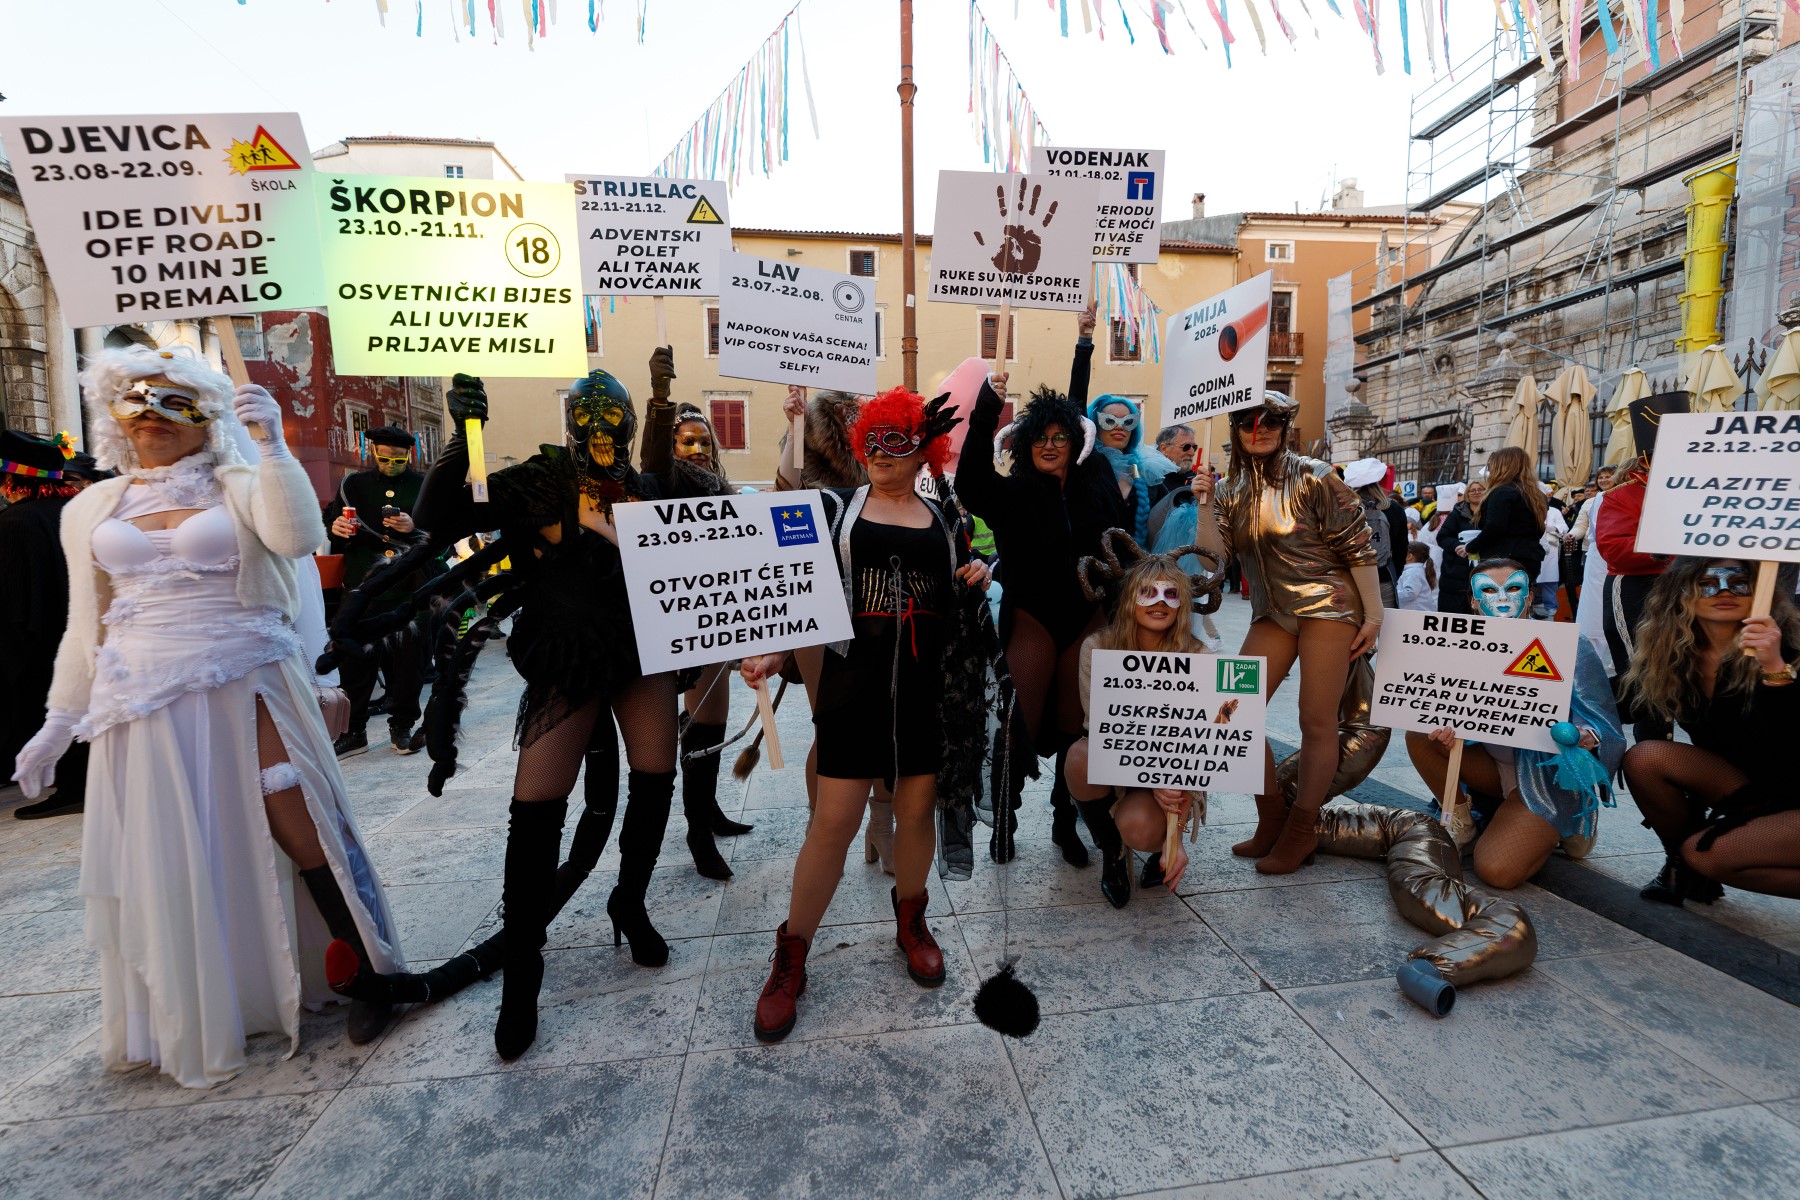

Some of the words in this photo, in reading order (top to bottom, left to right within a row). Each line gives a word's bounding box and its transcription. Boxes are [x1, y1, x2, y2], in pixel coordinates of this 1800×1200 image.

[21, 124, 211, 154] DJEVICA
[1046, 150, 1149, 168] VODENJAK
[32, 161, 203, 182] 23.08-22.09.
[1048, 170, 1122, 180] 2101.-18.02.
[251, 179, 297, 191] ŠKOLA
[574, 180, 697, 199] STRIJELAC
[330, 179, 524, 218] ŠKORPION
[582, 202, 666, 213] 22.11-21.12.
[83, 208, 143, 231] IDE
[153, 202, 263, 227] DIVLJI
[1096, 217, 1116, 228] ĆE
[1119, 218, 1154, 229] MOĆI
[338, 218, 484, 238] 23.10.-21.11.
[590, 228, 700, 242] ADVENTSKI
[1109, 231, 1144, 242] VAŠE
[86, 236, 154, 258] OFF
[166, 230, 275, 254] ROAD-
[516, 236, 550, 264] 18
[617, 245, 680, 257] POLET
[1092, 244, 1131, 256] DIŠTE
[112, 264, 147, 285] 10
[158, 259, 222, 282] MIN
[232, 256, 268, 276] JE
[597, 261, 629, 272] ALI
[635, 262, 700, 274] TANAK
[758, 260, 800, 282] LAV
[599, 274, 702, 290] NOVČANIK
[940, 270, 975, 281] RUKE
[978, 272, 996, 282] SU
[998, 272, 1024, 284] VAM
[1027, 273, 1080, 288] ŠPORKE
[116, 282, 282, 312] PREMALO
[338, 282, 496, 302] OSVETNIČKI
[504, 287, 572, 304] BIJES
[732, 276, 824, 302] 23.07.-22.08.
[934, 284, 938, 294] I
[941, 284, 984, 296] SMRDI
[986, 288, 1012, 298] VAM
[1014, 290, 1027, 300] IZ
[1030, 291, 1064, 303] USTA
[390, 310, 430, 326] ALI
[439, 312, 529, 328] UVIJEK
[835, 314, 863, 324] CENTAR
[1184, 299, 1227, 331] ZMIJA
[726, 322, 790, 338] NAPOKON
[792, 332, 823, 344] VAŠA
[826, 337, 868, 350] SCENA!
[1194, 324, 1218, 342] 2025.
[368, 336, 481, 352] PRLJAVE
[488, 338, 554, 354] MISLI
[724, 337, 744, 346] VIP
[748, 341, 781, 352] GOST
[783, 346, 824, 359] SVOGA
[826, 352, 870, 366] GRADA!
[780, 361, 820, 374] SELFY!
[1189, 373, 1235, 398] GODINA
[1174, 387, 1252, 420] PROMJE(N)RE
[1706, 415, 1800, 434] JARA
[920, 478, 936, 495] EU
[1666, 476, 1792, 492] ULAZITE
[654, 500, 738, 524] VAGA
[1702, 496, 1800, 512] PROJE
[1683, 514, 1702, 526] U
[638, 524, 763, 548] 23.09.-22.10.
[1683, 532, 1730, 546] 100
[1738, 536, 1800, 550] GOD
[649, 568, 752, 594] OTVORIT
[758, 563, 784, 581] ĆE
[790, 562, 814, 576] TE
[660, 590, 738, 614] VRATA
[744, 580, 812, 602] NAŠIM
[698, 603, 788, 629] DRAGIM
[1422, 616, 1486, 635] RIBE
[670, 618, 819, 654] STUDENTIMA
[1402, 634, 1513, 654] 19.02.-20.03.
[1122, 654, 1191, 674] OVAN
[1103, 677, 1199, 692] 21.03.-20.04.
[1403, 672, 1436, 684] VAŠ
[1441, 676, 1539, 698] WELLNESS
[1384, 684, 1450, 700] CENTAR
[1455, 693, 1468, 702] U
[1473, 694, 1558, 714] VRULJICI
[1108, 704, 1208, 721] USKRŠNJA
[1379, 696, 1408, 707] BIT
[1410, 697, 1432, 710] ĆE
[1435, 701, 1559, 729] PRIVREMENO
[1099, 721, 1147, 736] BOŽE
[1150, 725, 1211, 740] IZBAVI
[1216, 729, 1252, 742] NAS
[1417, 714, 1515, 736] ZATVOREN
[1102, 738, 1208, 756] SEZONCIMA
[1213, 745, 1219, 756] I
[1223, 746, 1248, 757] NE
[1119, 755, 1198, 770] DOZVOLI
[1204, 760, 1229, 772] DA
[1138, 772, 1210, 787] OSTANU
